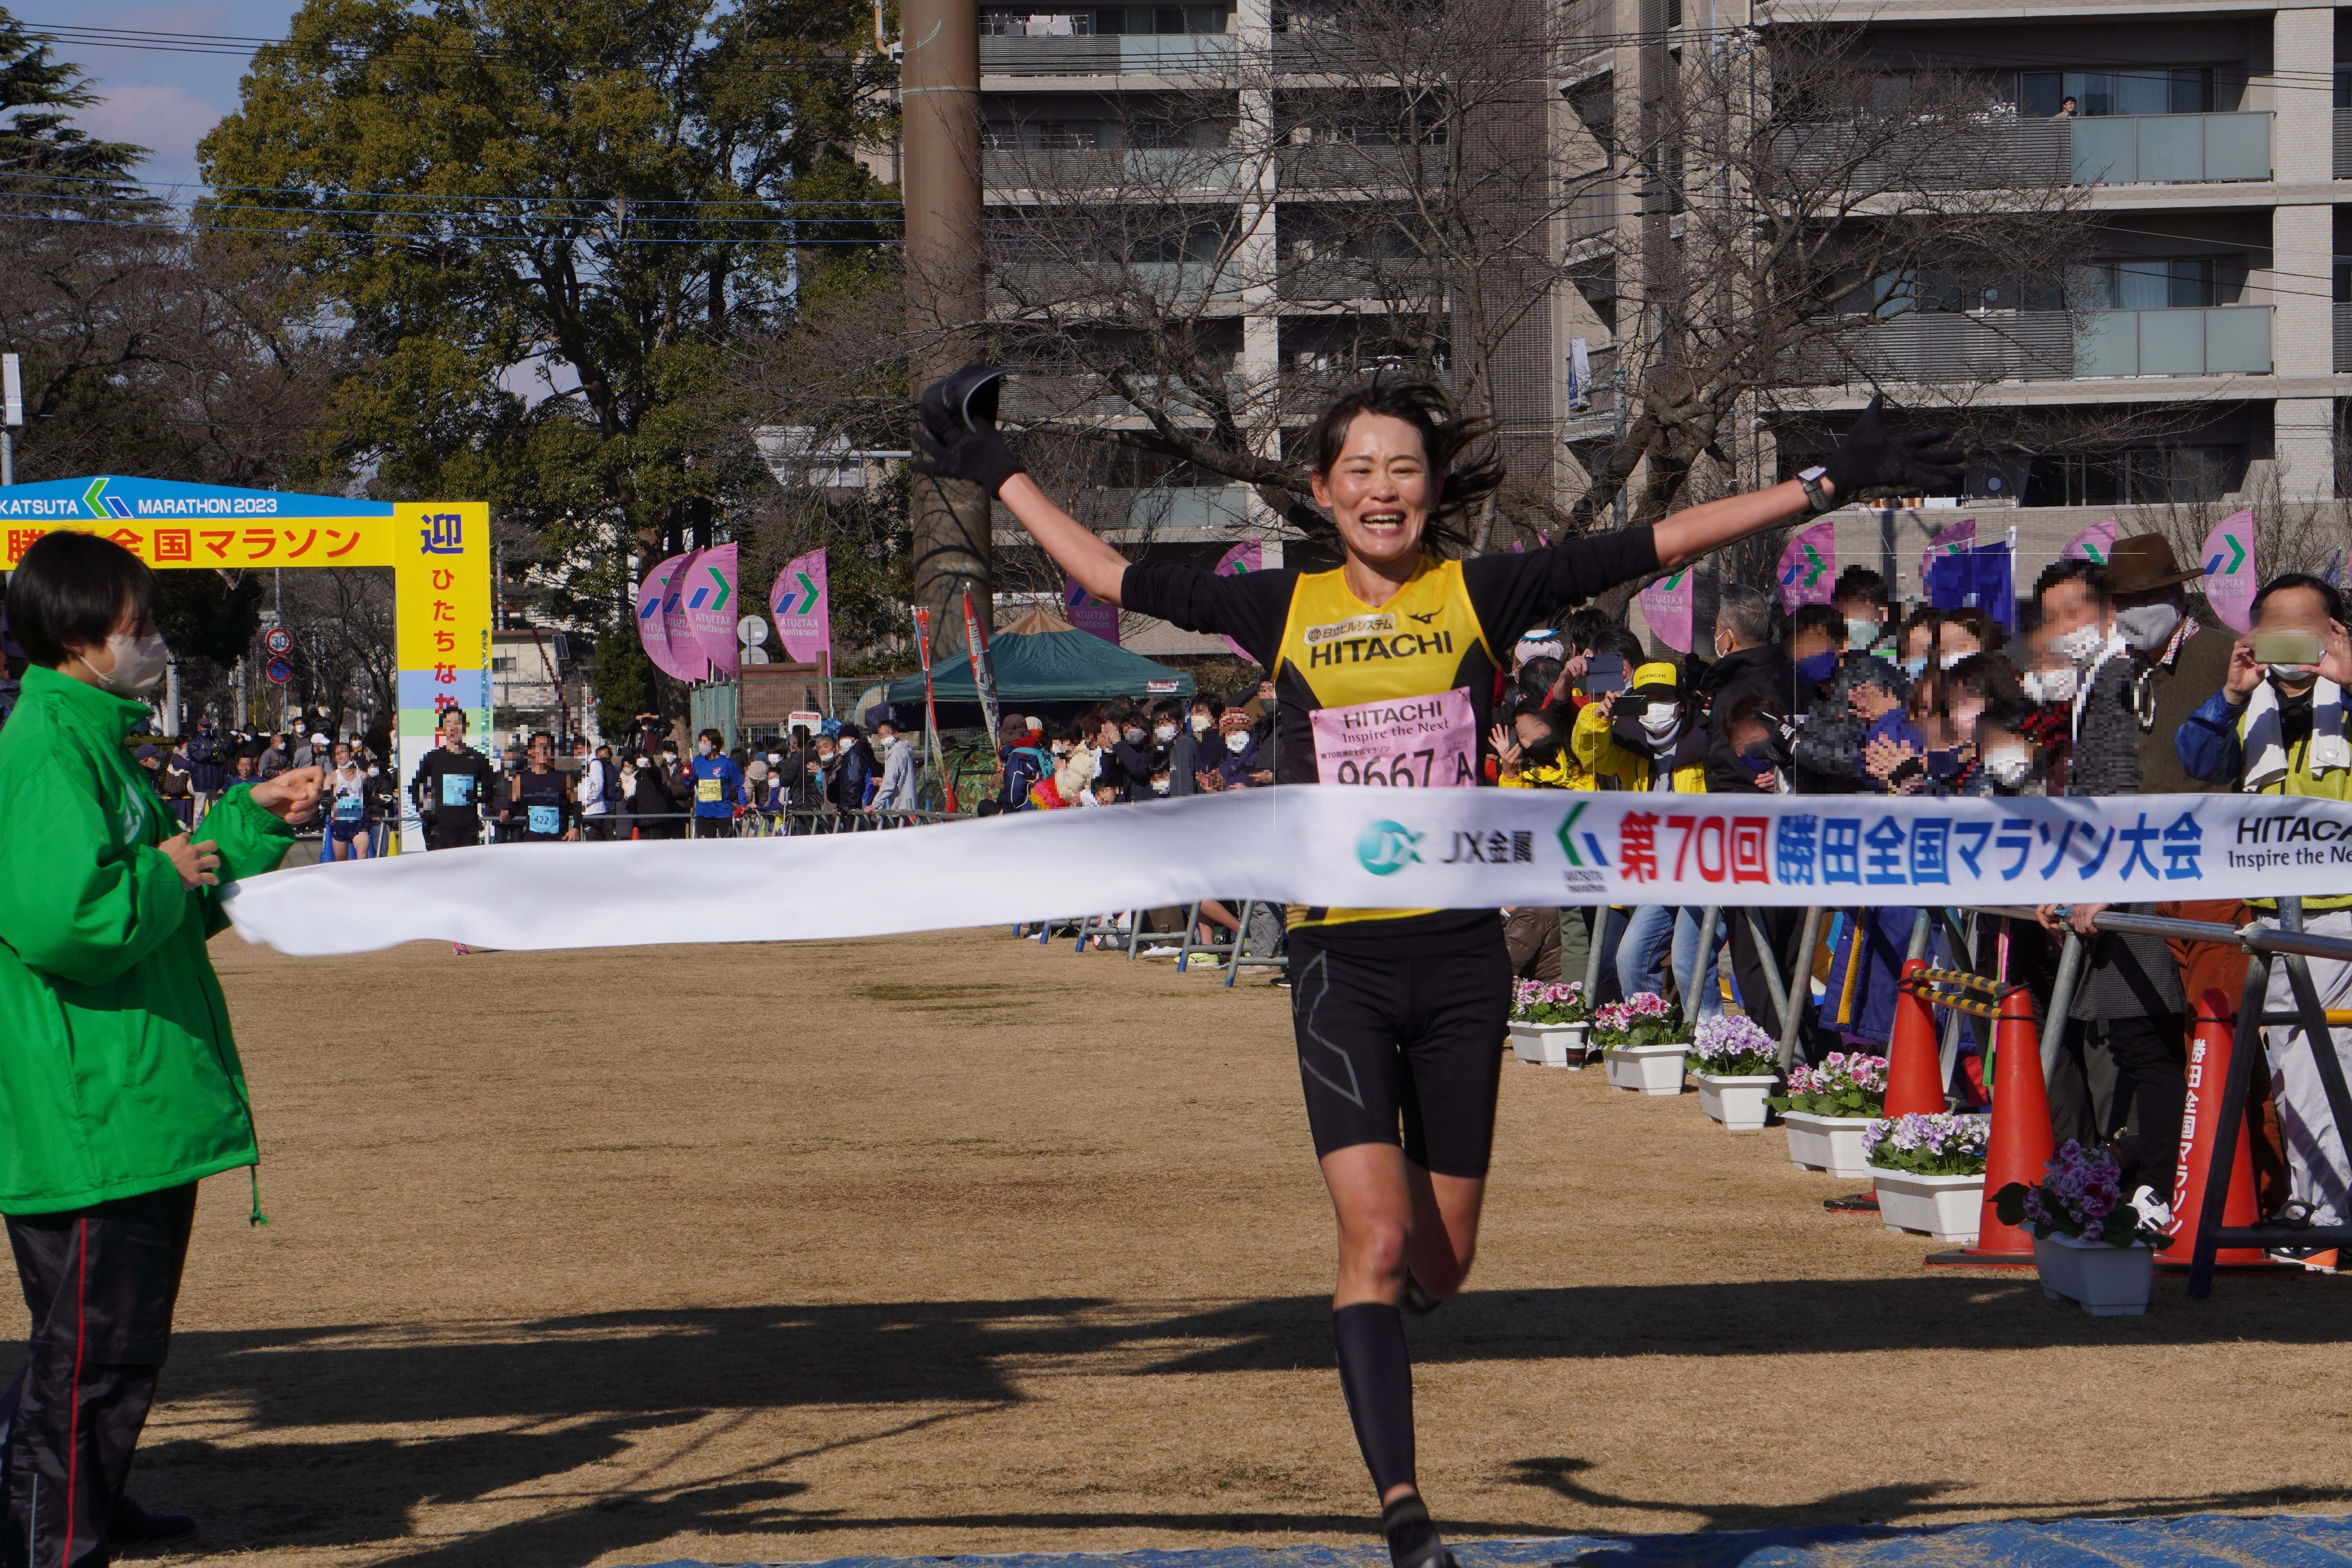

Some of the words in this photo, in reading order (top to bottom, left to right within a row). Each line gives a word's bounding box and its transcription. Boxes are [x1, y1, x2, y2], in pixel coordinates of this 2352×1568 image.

[0, 500, 79, 514] KATSUTA
[138, 498, 231, 514] MARATHON
[234, 498, 278, 514] 2023
[7, 528, 361, 563] 勝全国マラソン
[421, 513, 464, 555] 迎
[272, 636, 287, 647] 30
[1323, 619, 1393, 638] 日立ビルシステム
[432, 568, 457, 747] ひたちなか
[1310, 631, 1453, 668] HITACHI
[1342, 730, 1387, 743] Inspire
[1391, 726, 1413, 736] the
[1417, 717, 1449, 733] Next
[1343, 701, 1442, 729] HITACHI
[1456, 751, 1474, 784] A
[2228, 849, 2290, 872] Inspire
[2296, 847, 2324, 864] the
[2169, 1038, 2206, 1236] 勝田全国マラソン
